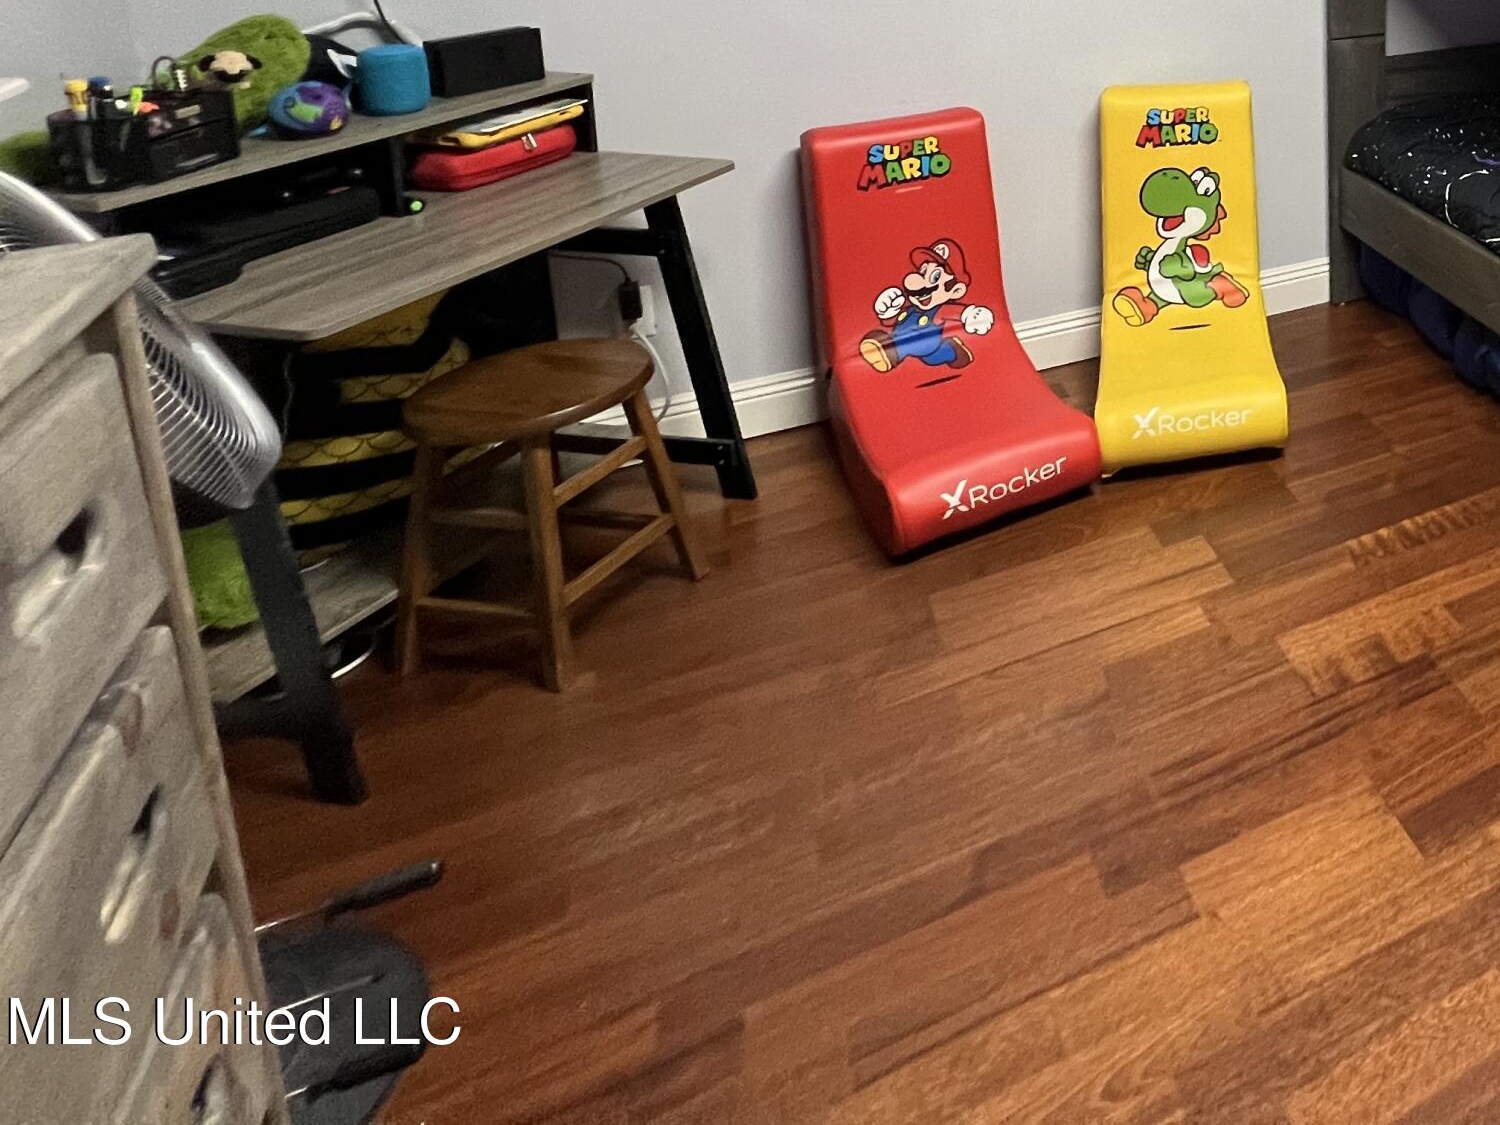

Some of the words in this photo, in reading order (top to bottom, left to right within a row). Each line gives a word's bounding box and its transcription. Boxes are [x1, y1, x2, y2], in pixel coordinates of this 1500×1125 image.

[1147, 106, 1210, 126] SUPER
[1136, 122, 1219, 148] MARIO
[868, 136, 939, 163] SUPER
[857, 152, 951, 191] MARIO
